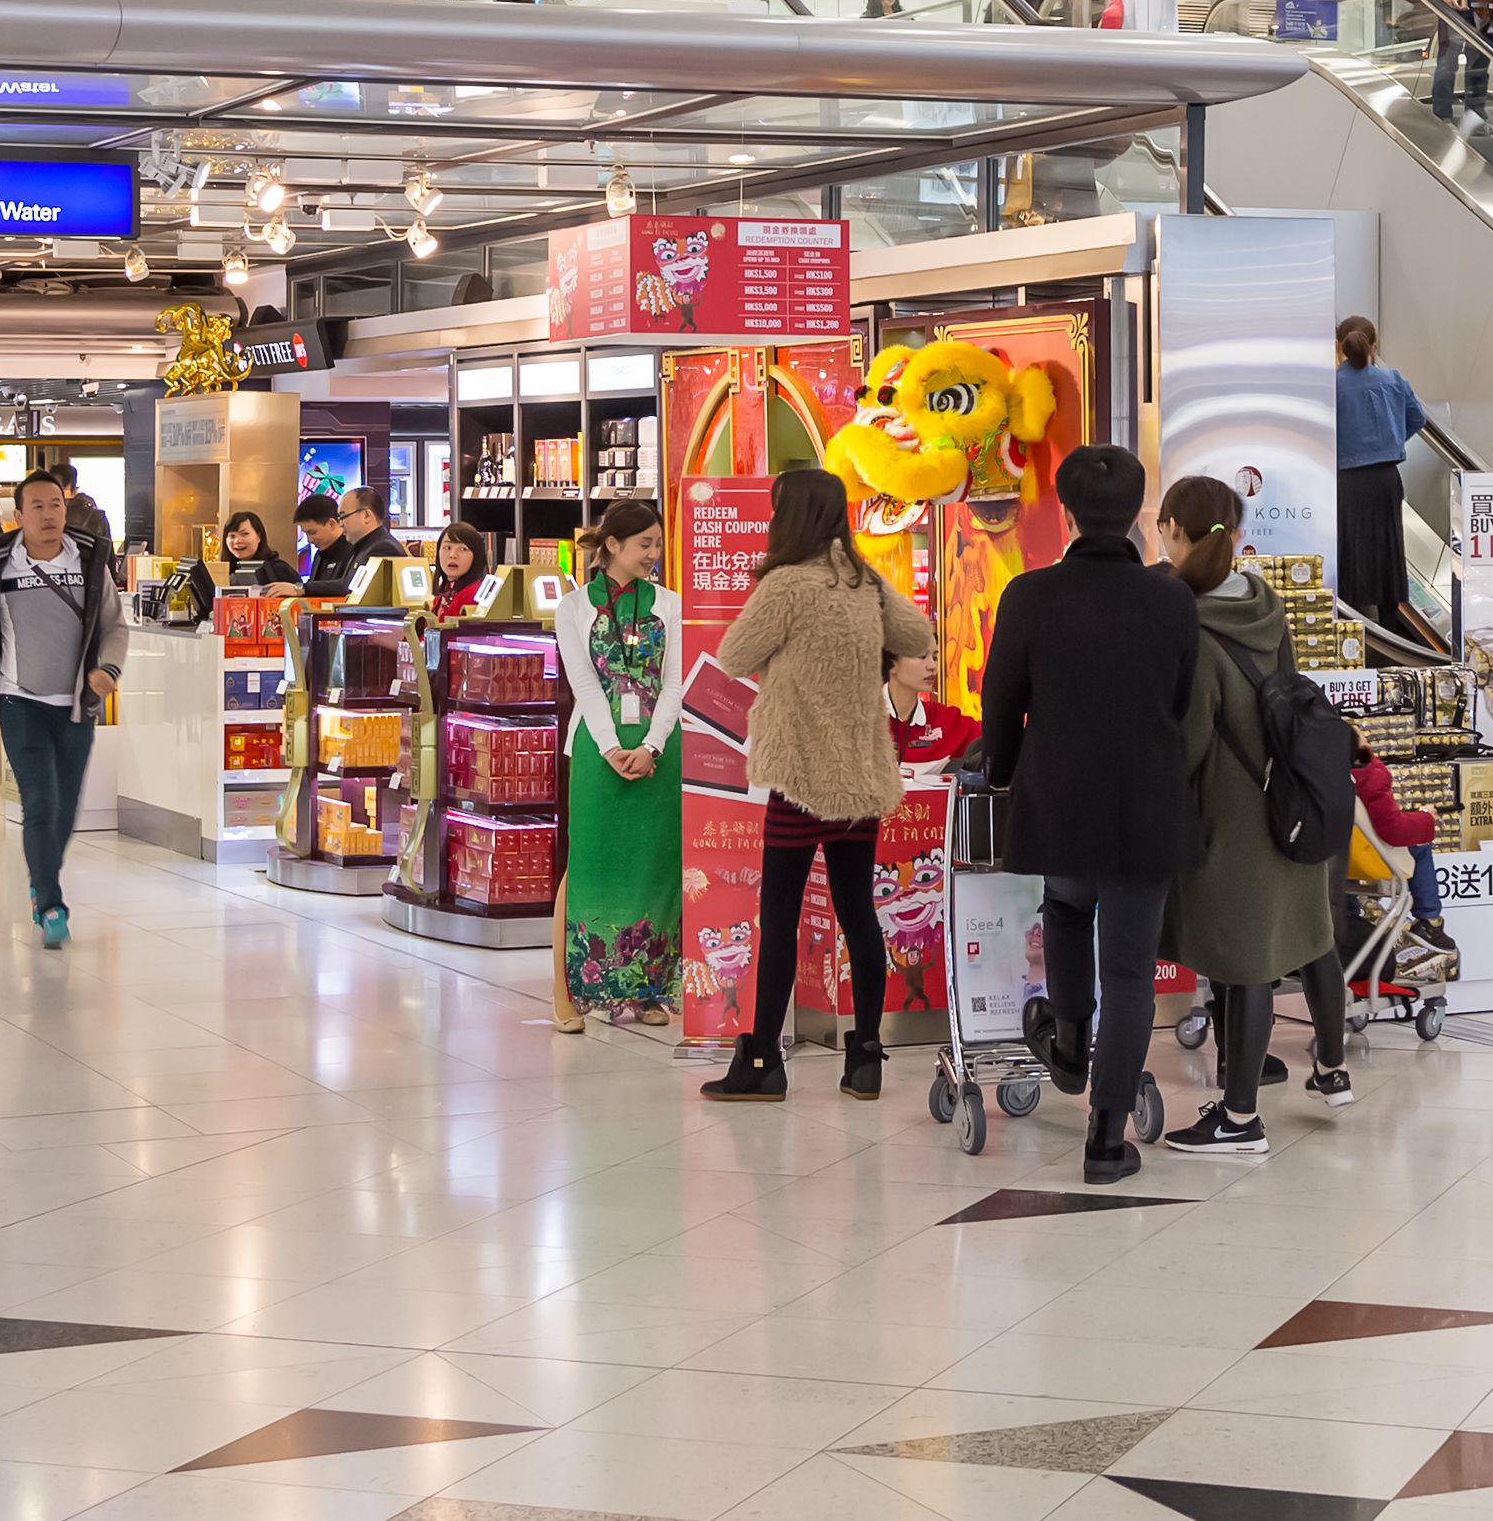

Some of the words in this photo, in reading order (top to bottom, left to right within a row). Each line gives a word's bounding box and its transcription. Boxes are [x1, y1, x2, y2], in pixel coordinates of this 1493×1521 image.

[0, 201, 61, 222] Water
[745, 236, 796, 245] REDEMPTION
[797, 237, 834, 246] COUNTER
[269, 341, 295, 364] FREE
[693, 507, 738, 519] REDEEM
[1255, 507, 1312, 519] KONG
[693, 521, 722, 534] CASH
[693, 535, 722, 548] HERE
[1470, 535, 1482, 558] 1
[692, 571, 751, 591] 現金券
[1329, 681, 1347, 693] BUY
[1348, 681, 1355, 692] 3
[1356, 681, 1372, 692] GET
[1330, 694, 1336, 706] 1
[1339, 693, 1372, 706] FREE
[1470, 816, 1493, 827] EXTRA
[903, 826, 918, 841] FA
[923, 826, 944, 840] CAI
[753, 838, 764, 849] CA
[1436, 865, 1493, 901] 3送1
